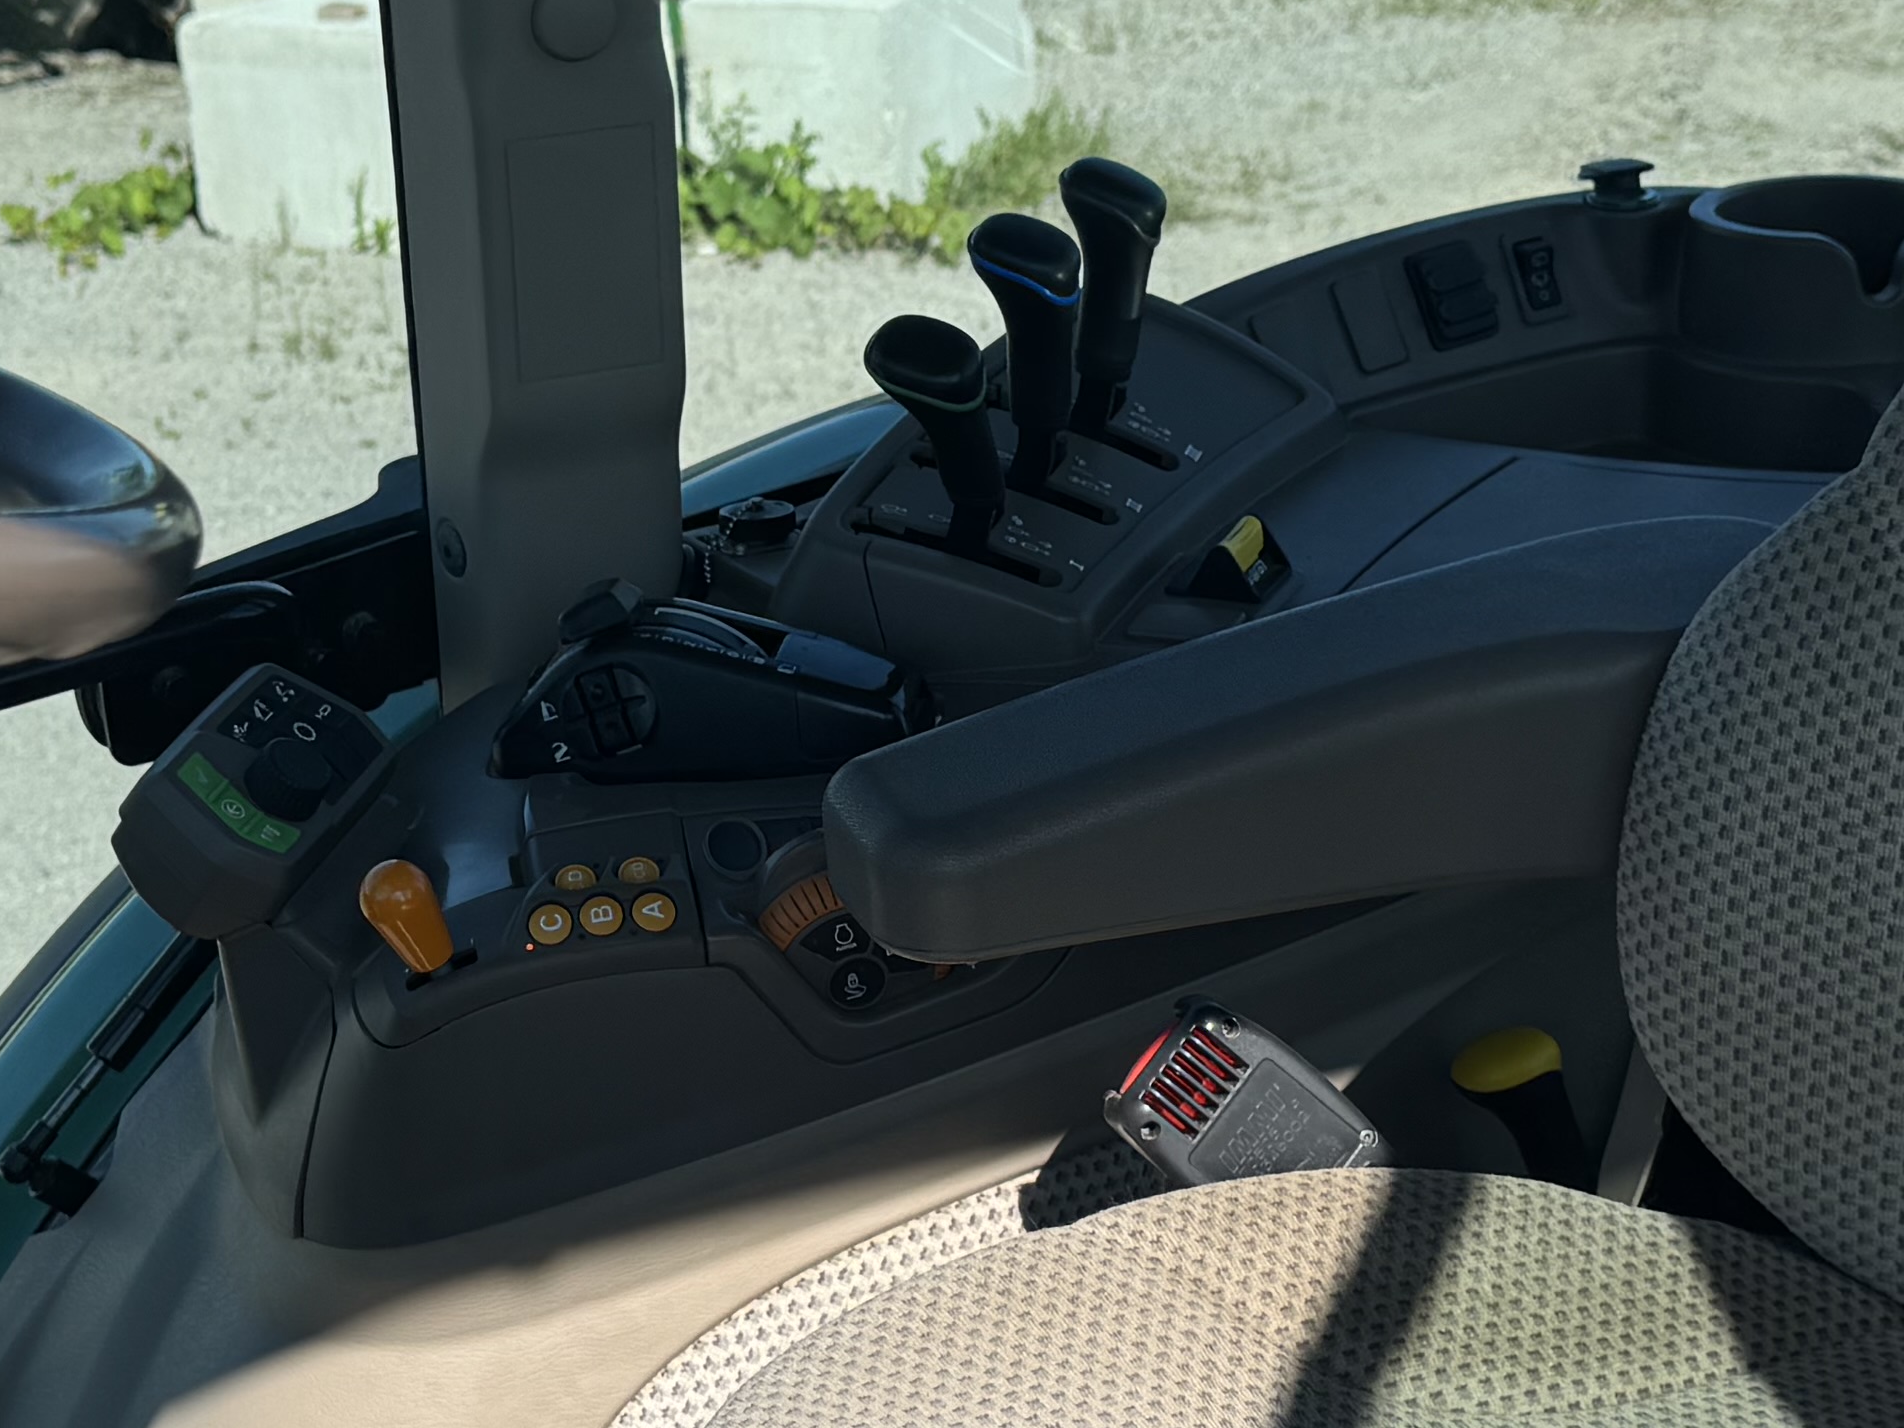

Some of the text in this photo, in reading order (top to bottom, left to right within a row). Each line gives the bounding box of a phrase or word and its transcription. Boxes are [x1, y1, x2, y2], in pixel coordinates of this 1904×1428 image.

[590, 905, 614, 924] B
[641, 900, 665, 919] A
[539, 913, 563, 932] C
